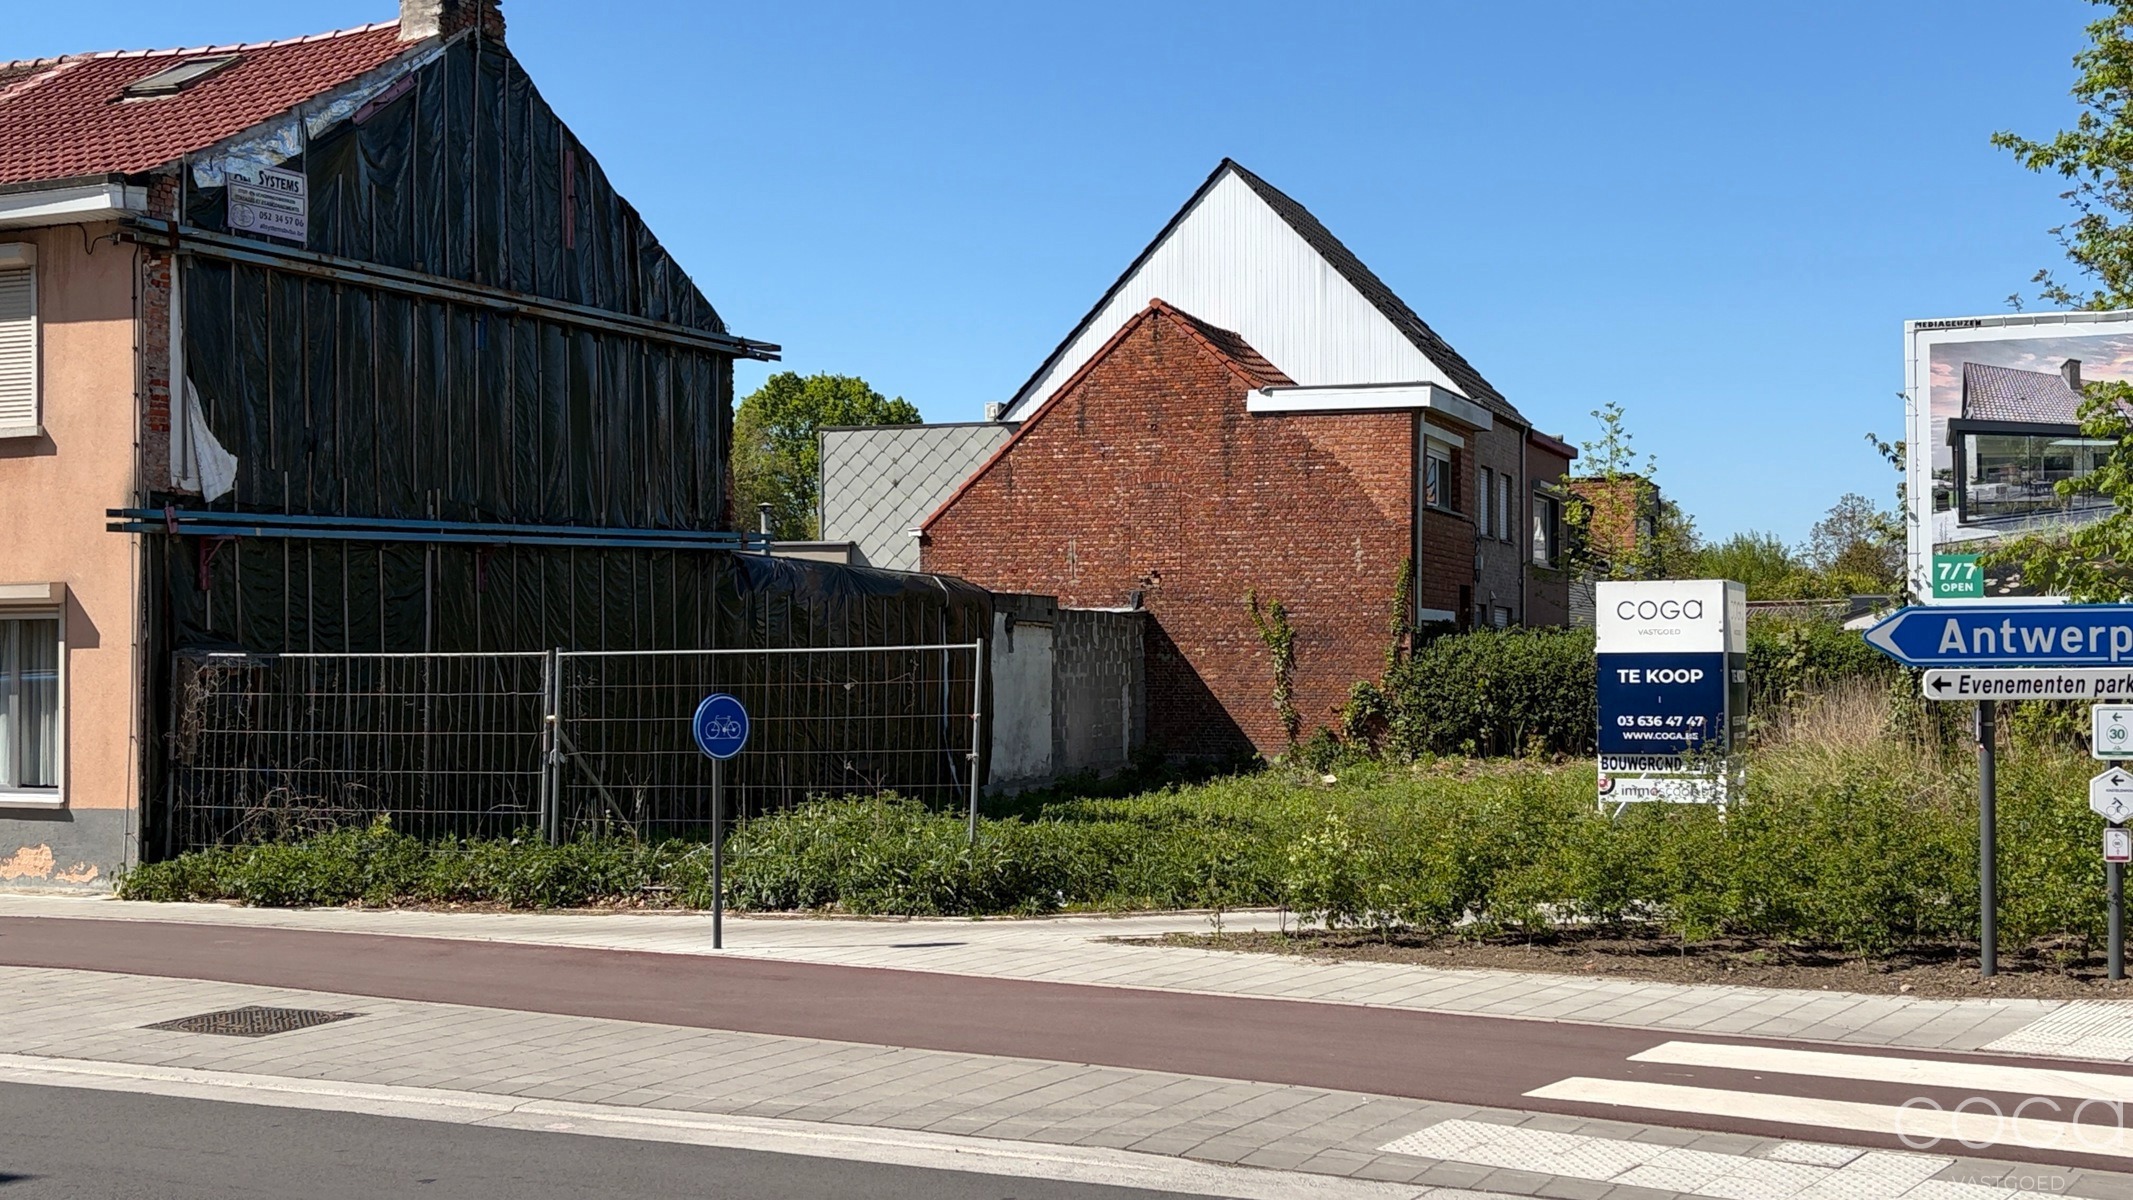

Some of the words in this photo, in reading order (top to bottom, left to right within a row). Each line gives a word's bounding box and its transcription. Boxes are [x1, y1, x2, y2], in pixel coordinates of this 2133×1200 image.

[258, 170, 300, 193] SYSTEMS
[258, 211, 272, 221] 052
[275, 214, 283, 223] 34
[284, 216, 294, 225] 57
[1938, 562, 1977, 580] 7/7
[1940, 582, 1974, 592] OPEN
[1638, 628, 1681, 636] VASTGOED
[1938, 618, 2133, 662] Antwerp
[1616, 669, 1641, 684] TE
[1645, 669, 1704, 684] KOOP
[1958, 674, 2086, 694] Evenementen
[1616, 715, 1635, 727] 03
[1636, 715, 1663, 727] 636
[1665, 715, 1683, 727] 47
[1685, 715, 1704, 727] 47
[2109, 728, 2126, 740] 30
[1601, 756, 1682, 771] BOUWGROND
